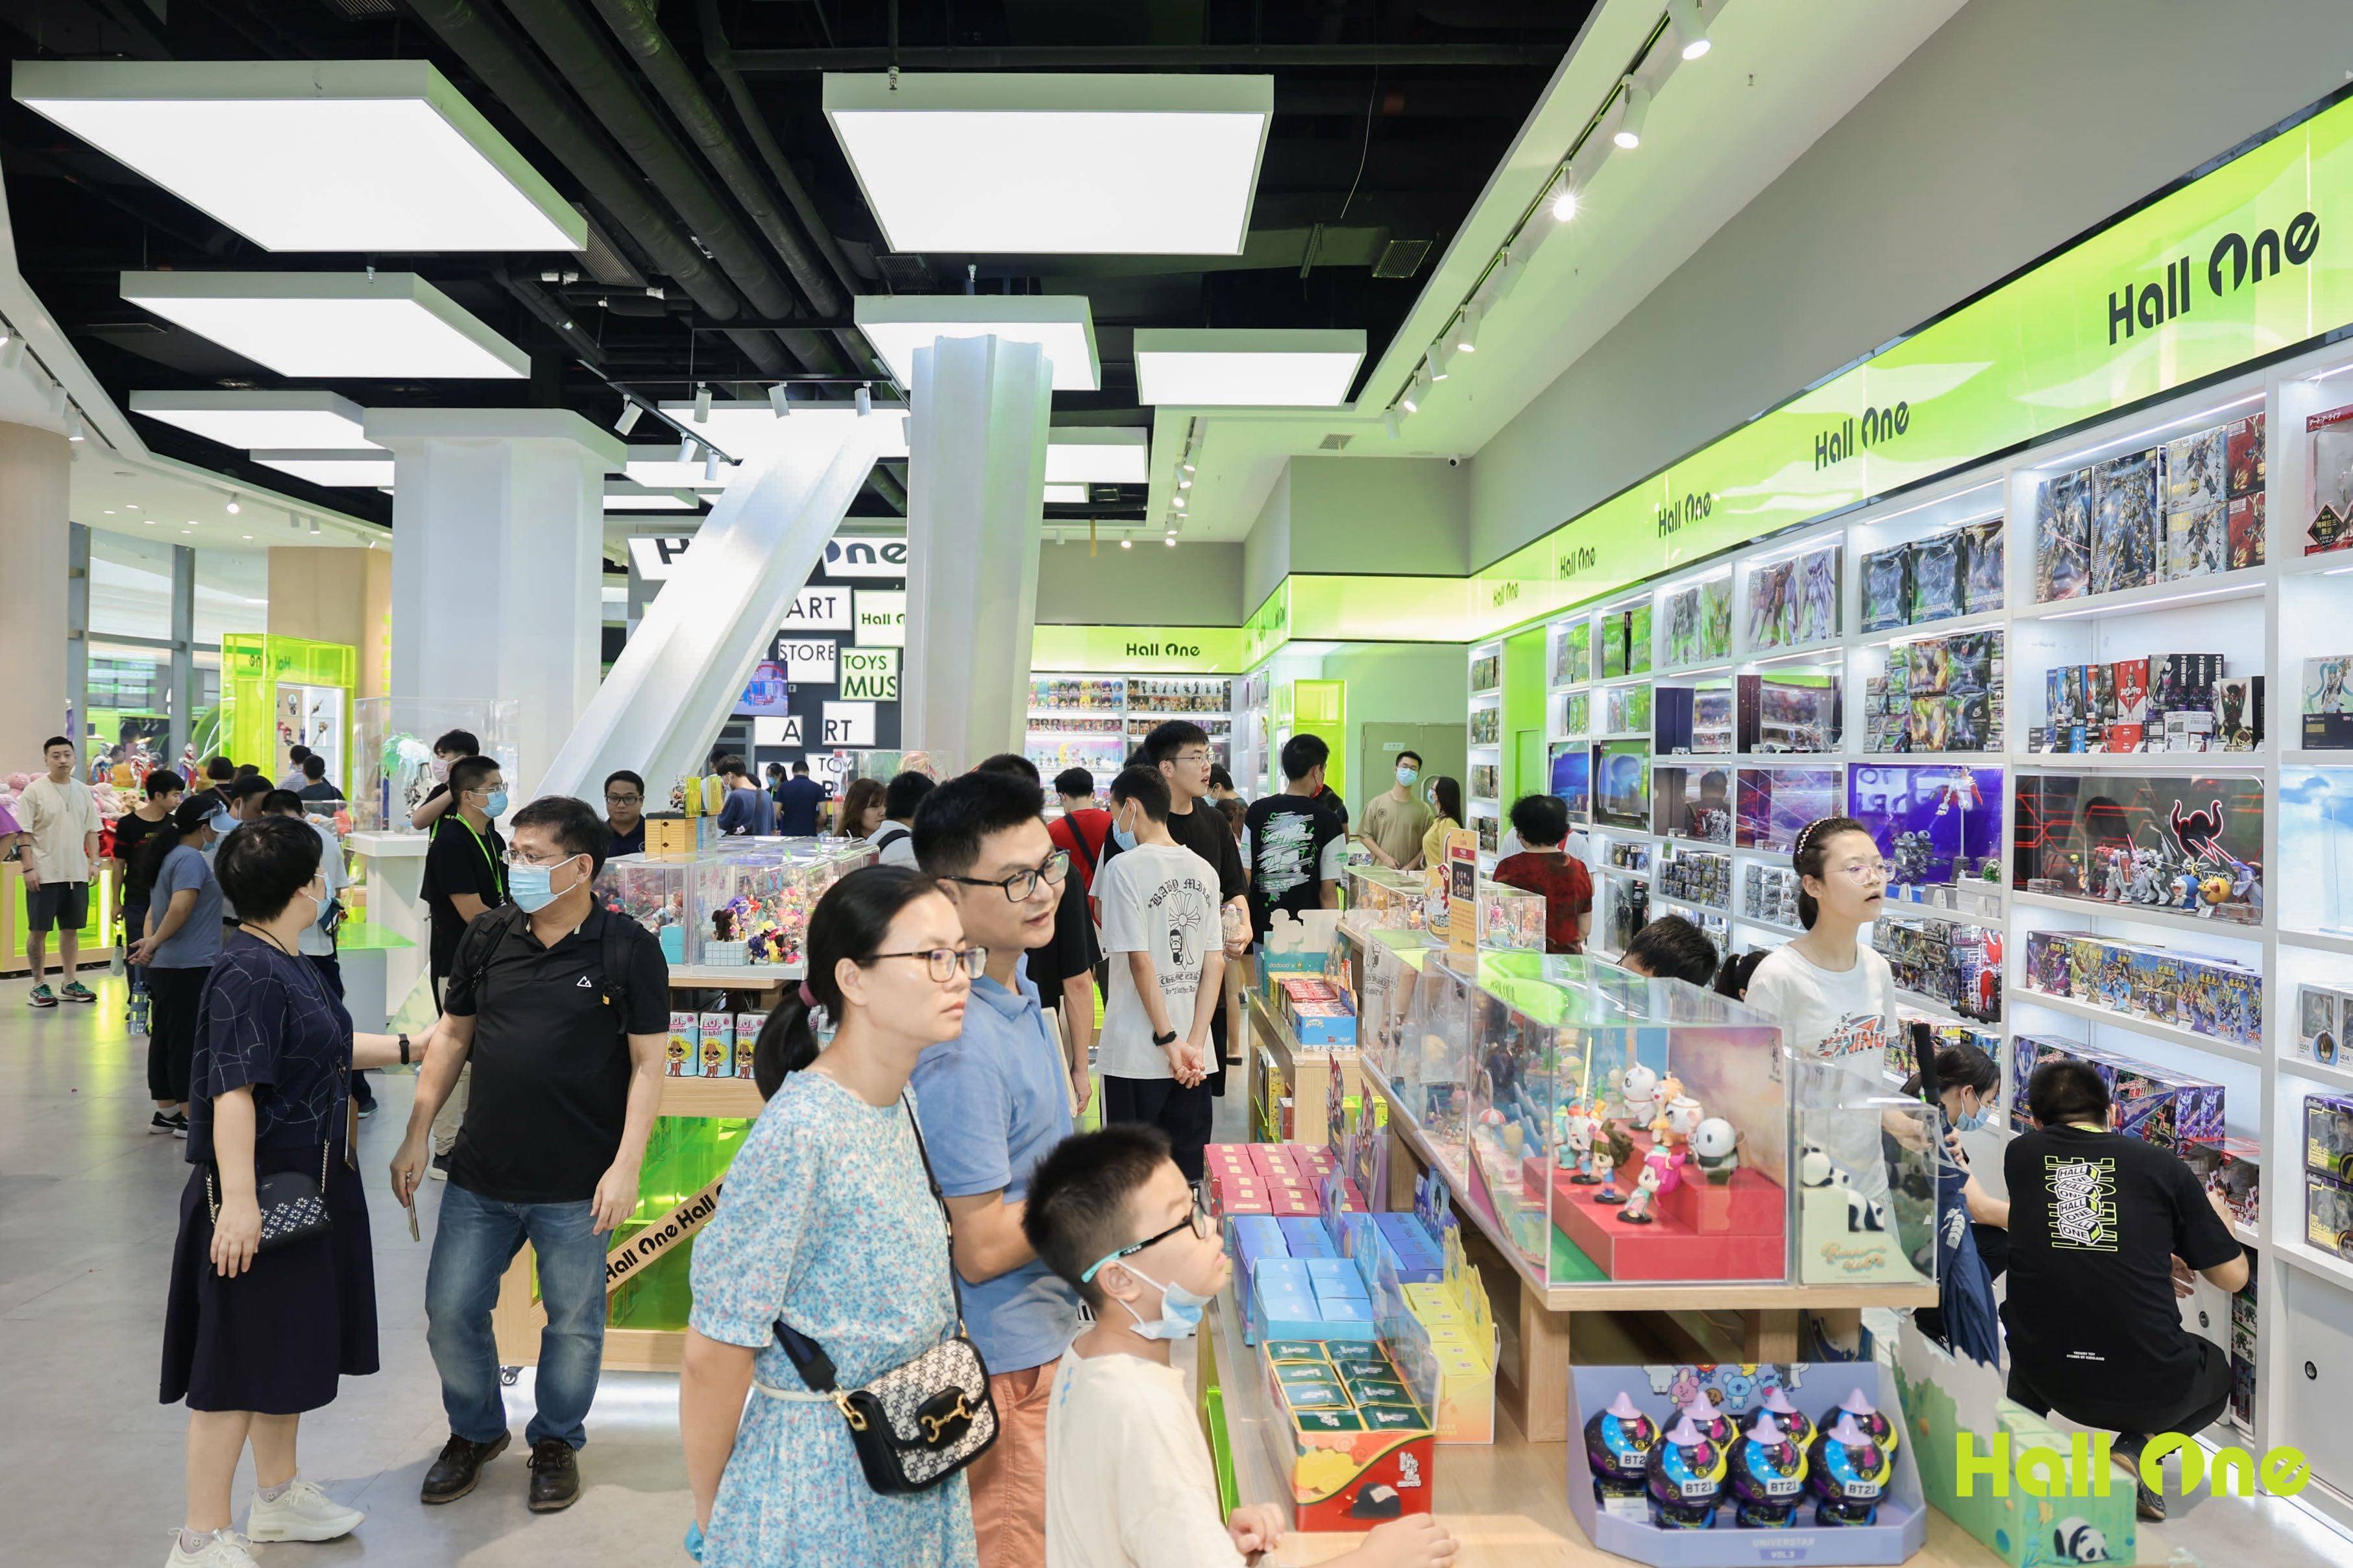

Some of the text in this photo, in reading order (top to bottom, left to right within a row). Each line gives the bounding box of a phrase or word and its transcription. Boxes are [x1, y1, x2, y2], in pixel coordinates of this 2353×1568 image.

[2108, 211, 2321, 346] Hall One
[1815, 400, 1910, 472] Hall One
[1658, 491, 1712, 538] Hall One
[1560, 546, 1596, 580] Hall One
[1492, 581, 1519, 609] Hall One
[785, 596, 836, 618] ART
[861, 612, 890, 625] Hall
[1126, 642, 1201, 657] Hall One
[843, 655, 887, 670] TOYS
[844, 675, 896, 698] MUS
[2059, 1166, 2086, 1177] HALL
[2060, 1181, 2089, 1192] HALL
[2060, 1200, 2085, 1212] HALL
[2066, 1209, 2091, 1221] ONE
[606, 1194, 716, 1284] Hall One Hall
[2062, 1226, 2088, 1239] ONE
[1624, 1454, 1646, 1464] BT2
[1685, 1481, 1712, 1492] BT21
[1770, 1480, 1797, 1492] BT21
[1849, 1484, 1875, 1495] BT21
